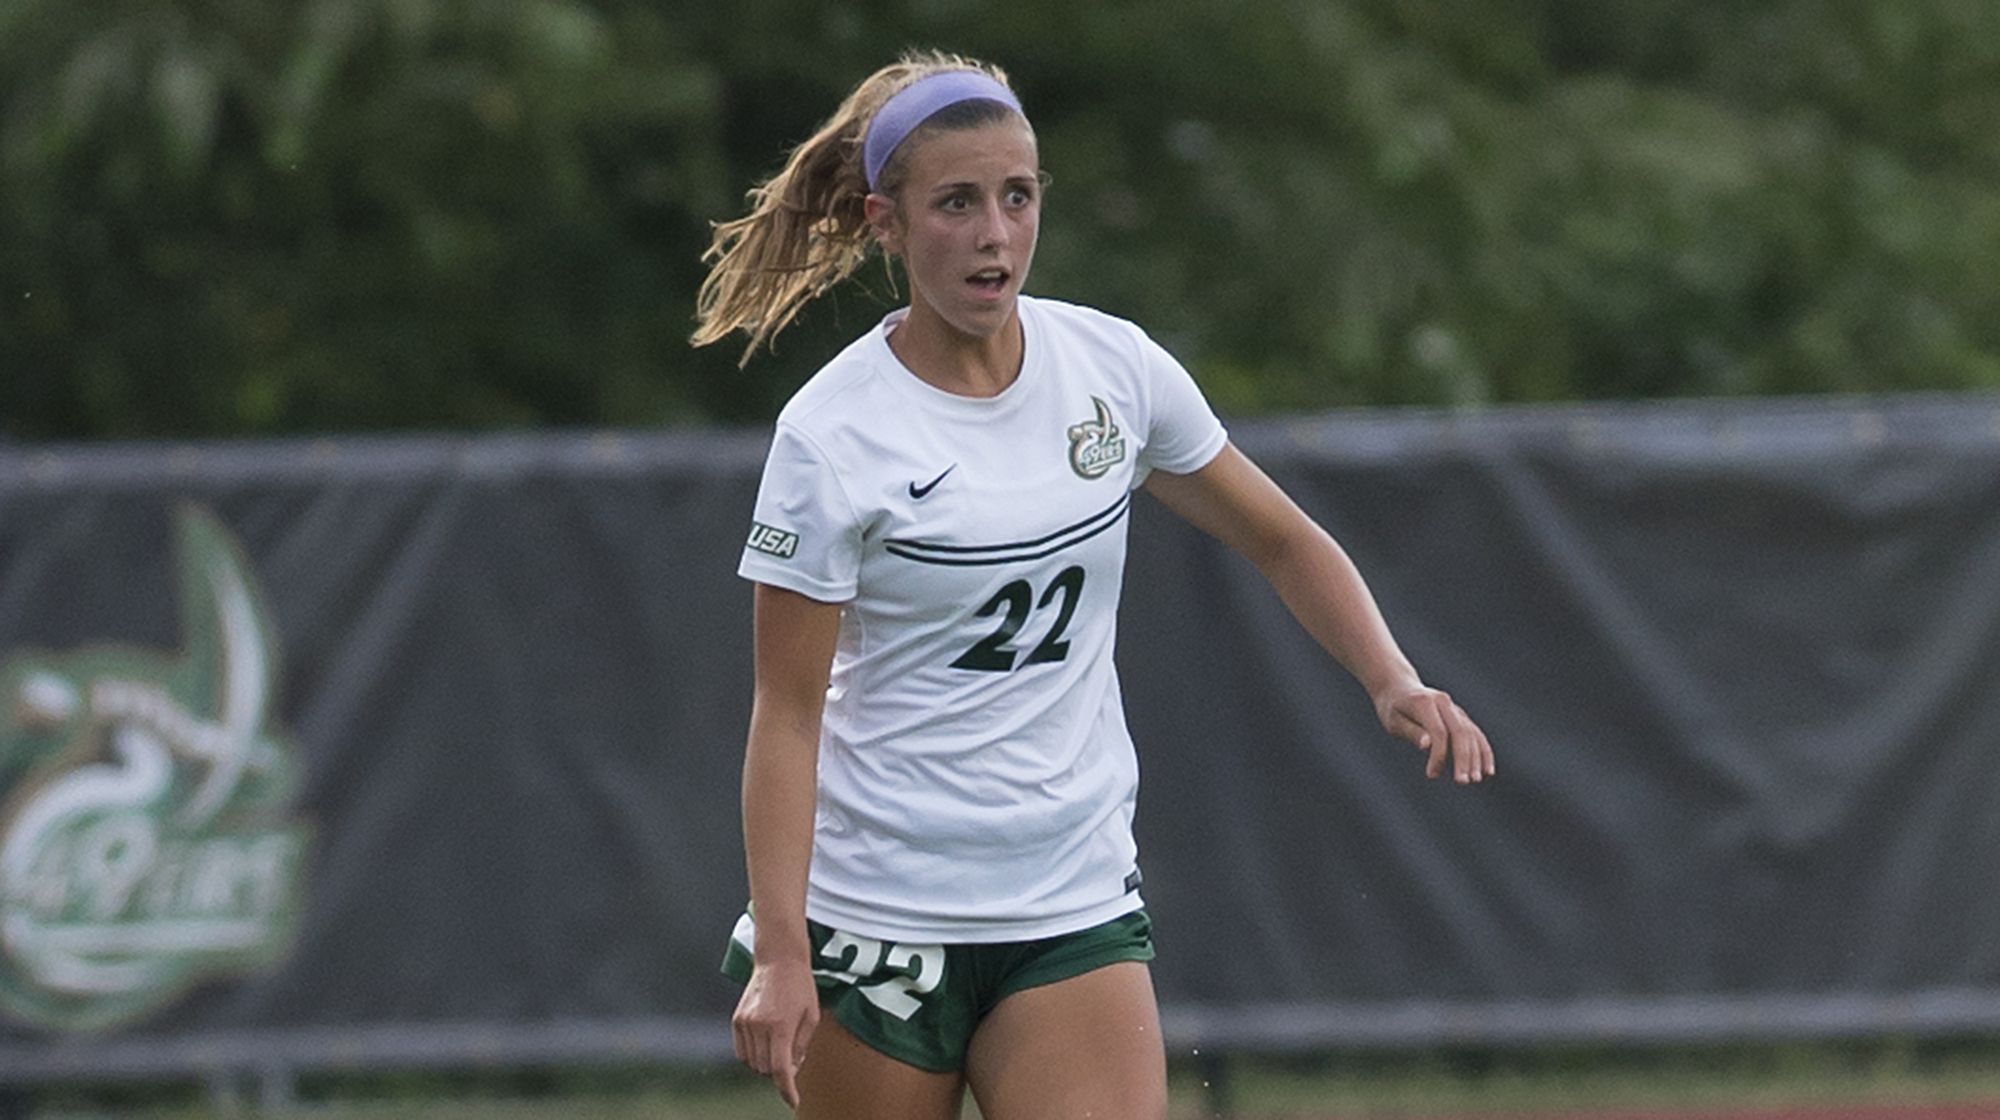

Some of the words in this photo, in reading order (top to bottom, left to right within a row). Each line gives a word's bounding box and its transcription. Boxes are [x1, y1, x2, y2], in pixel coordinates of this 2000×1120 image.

[748, 525, 797, 556] USA
[948, 565, 1085, 672] 22
[811, 930, 946, 1021] 22
